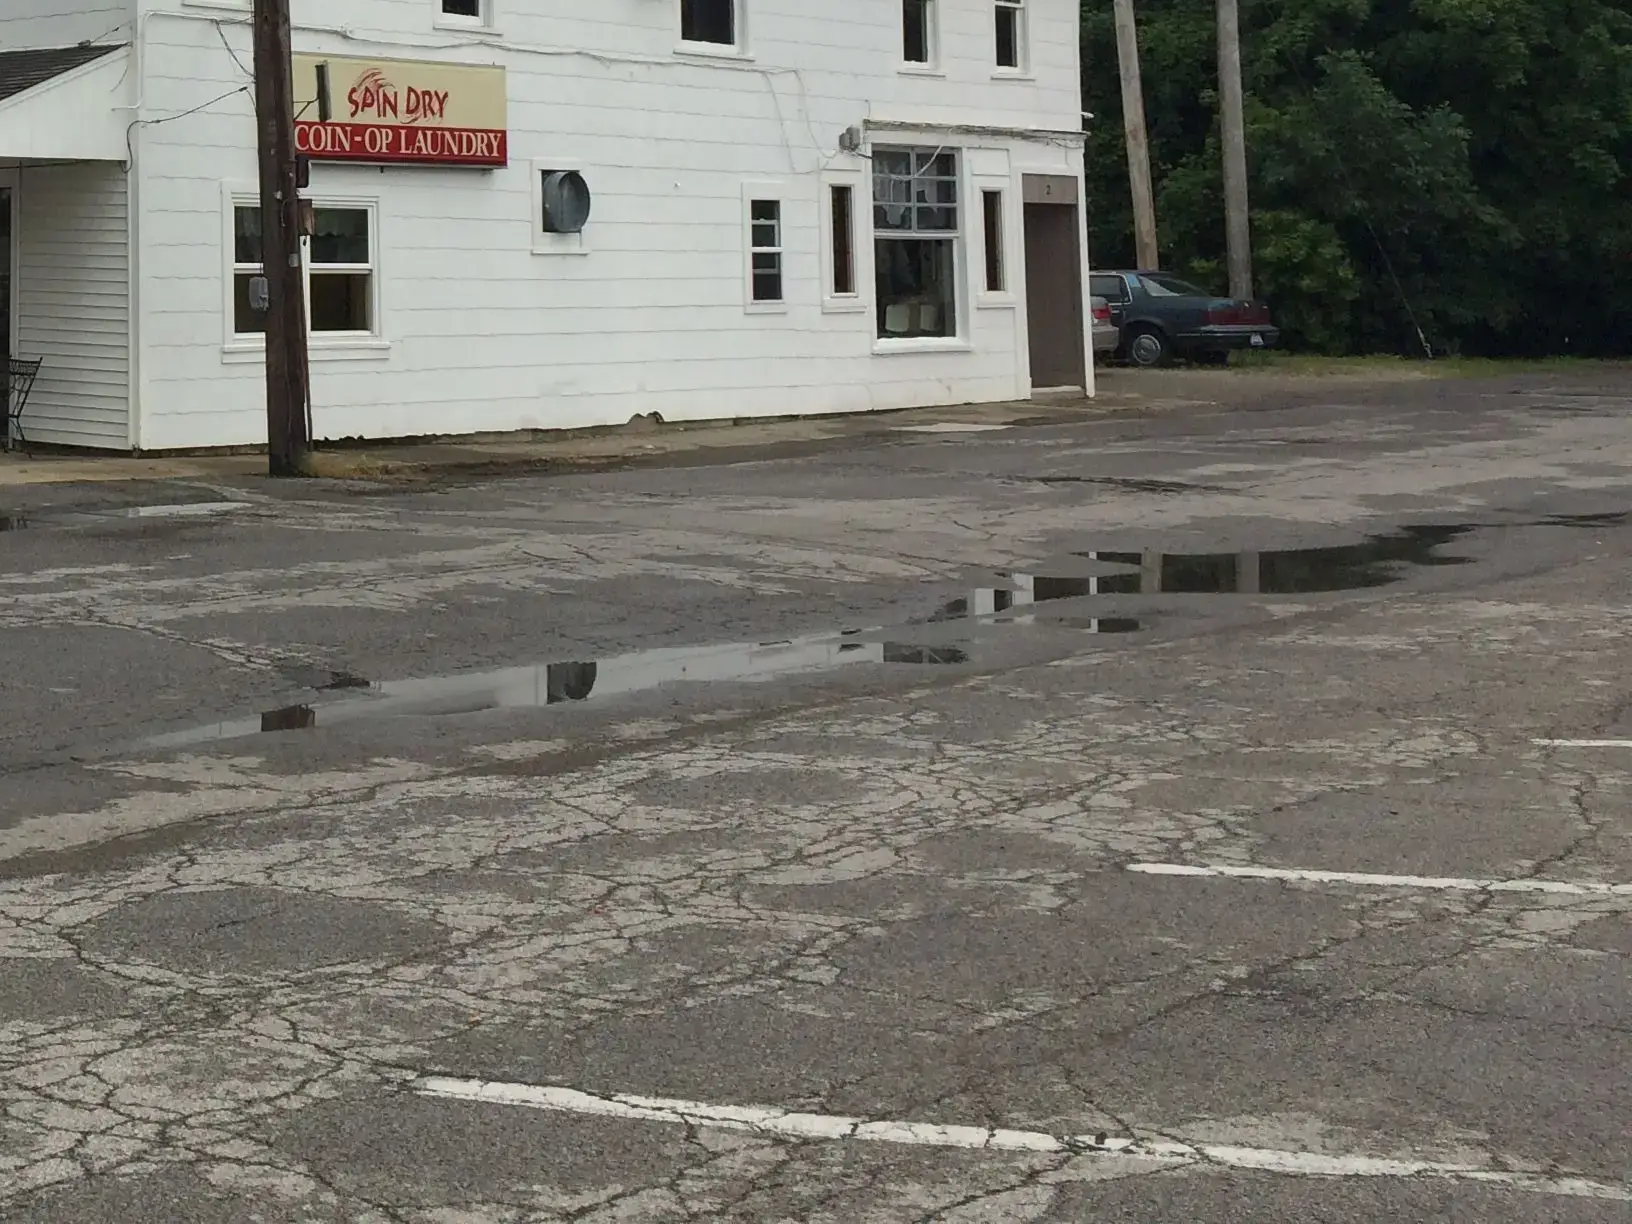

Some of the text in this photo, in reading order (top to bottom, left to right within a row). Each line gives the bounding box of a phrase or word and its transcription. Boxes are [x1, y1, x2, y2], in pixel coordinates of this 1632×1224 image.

[347, 84, 449, 119] SPIN DRY
[294, 124, 503, 157] COIN-OP LAUNDRY
[1045, 184, 1052, 195] 2
